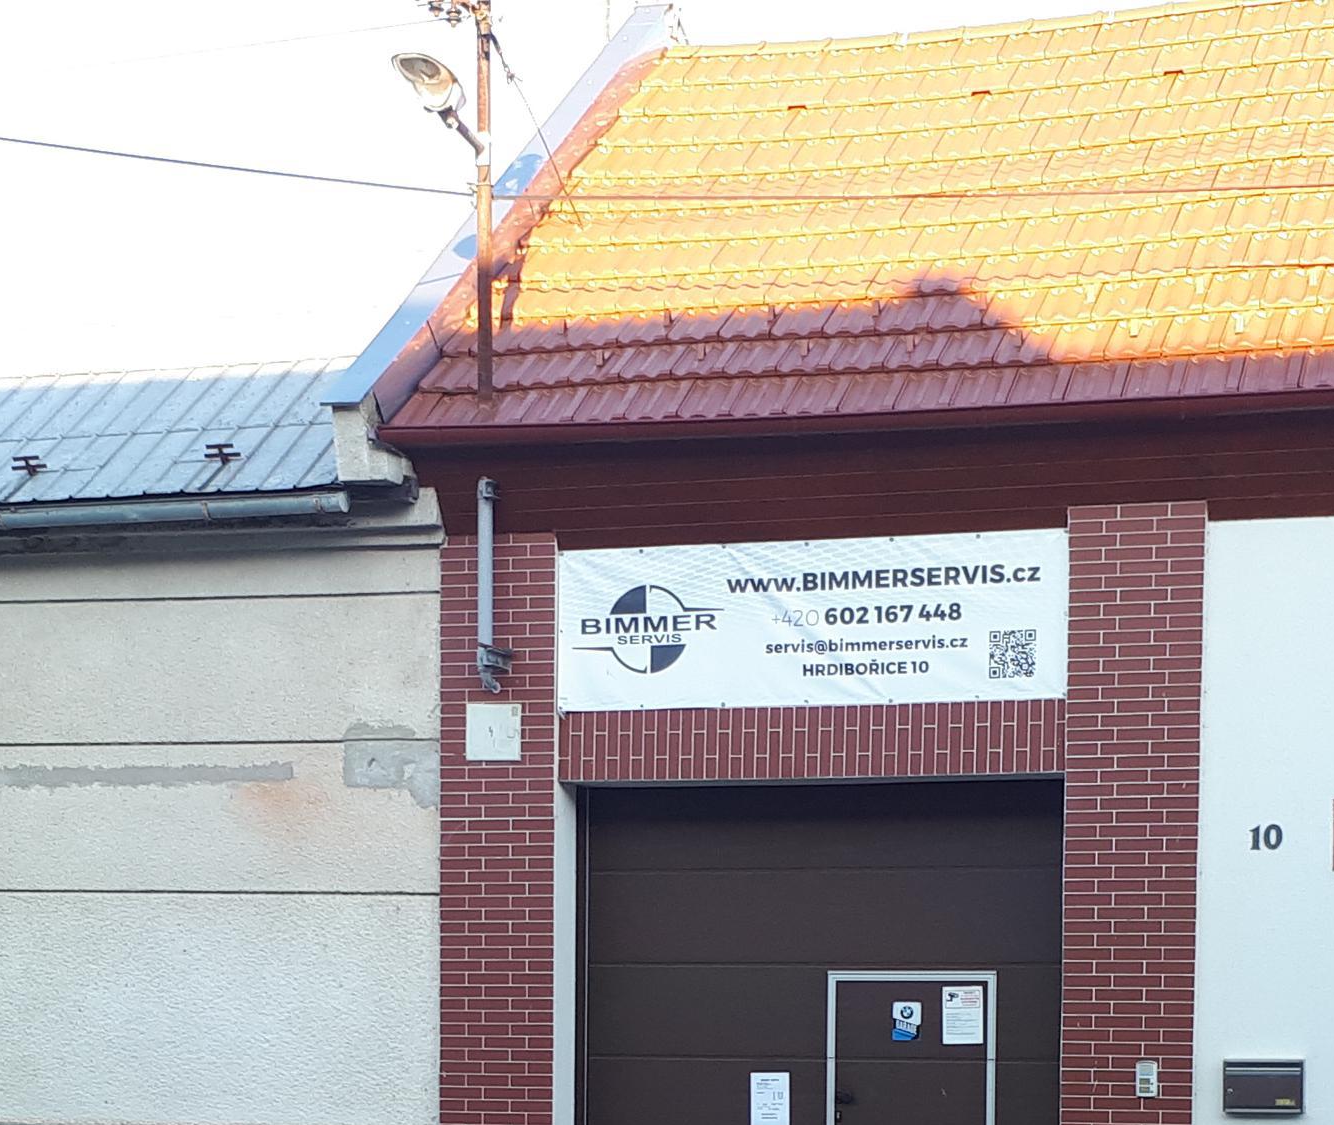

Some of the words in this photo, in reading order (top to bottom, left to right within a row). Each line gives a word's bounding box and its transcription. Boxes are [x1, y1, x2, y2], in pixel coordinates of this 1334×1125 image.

[726, 564, 1041, 593] www.BIMMERSERVIS.cz
[581, 613, 717, 635] BIMMER
[771, 609, 820, 627] +420
[824, 607, 870, 626] 602
[874, 605, 914, 624] 167
[918, 602, 962, 622] 448
[617, 633, 682, 645] SERVIS
[765, 634, 968, 655] servis@bimmerservis.cz
[802, 659, 908, 677] HRDIBOŘICE
[911, 661, 929, 674] 10
[1249, 824, 1283, 850] 10
